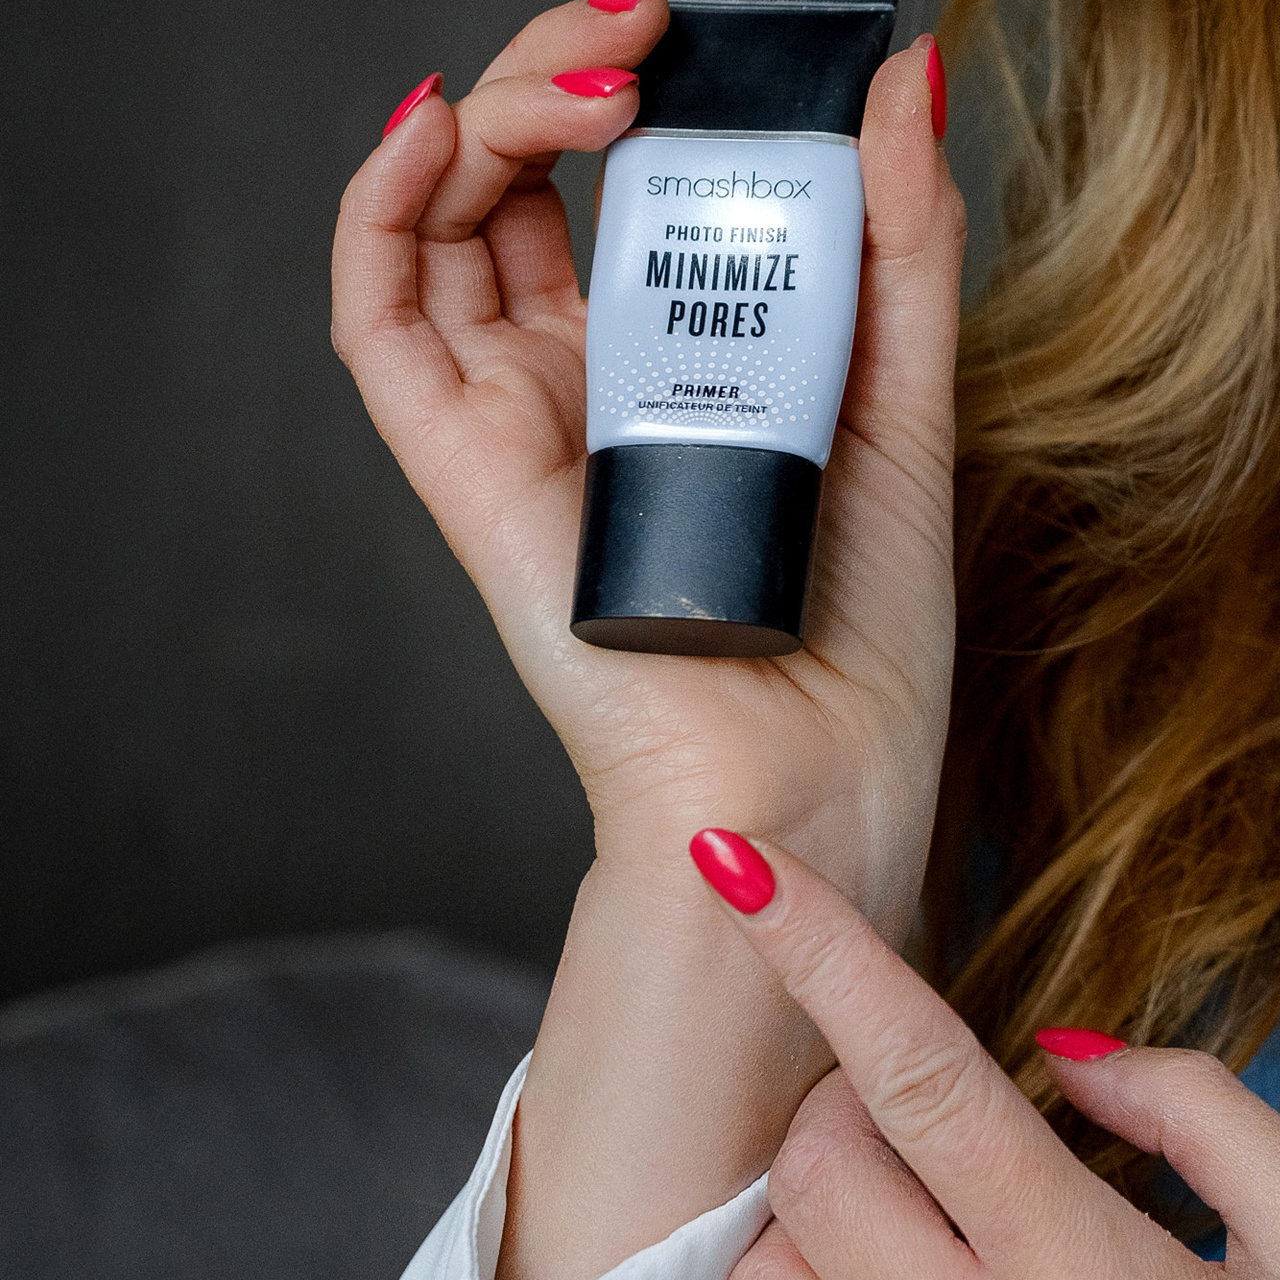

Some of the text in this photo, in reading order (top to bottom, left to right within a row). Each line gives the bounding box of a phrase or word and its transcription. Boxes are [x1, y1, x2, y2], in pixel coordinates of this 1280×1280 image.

[646, 171, 812, 199] smashbox
[665, 224, 788, 243] PHOTO FINISH
[646, 250, 799, 292] MINIMIZE
[666, 299, 769, 338] PORES
[671, 384, 740, 399] PRIMER
[638, 401, 768, 414] UNIFICATEUR DE TEINT
